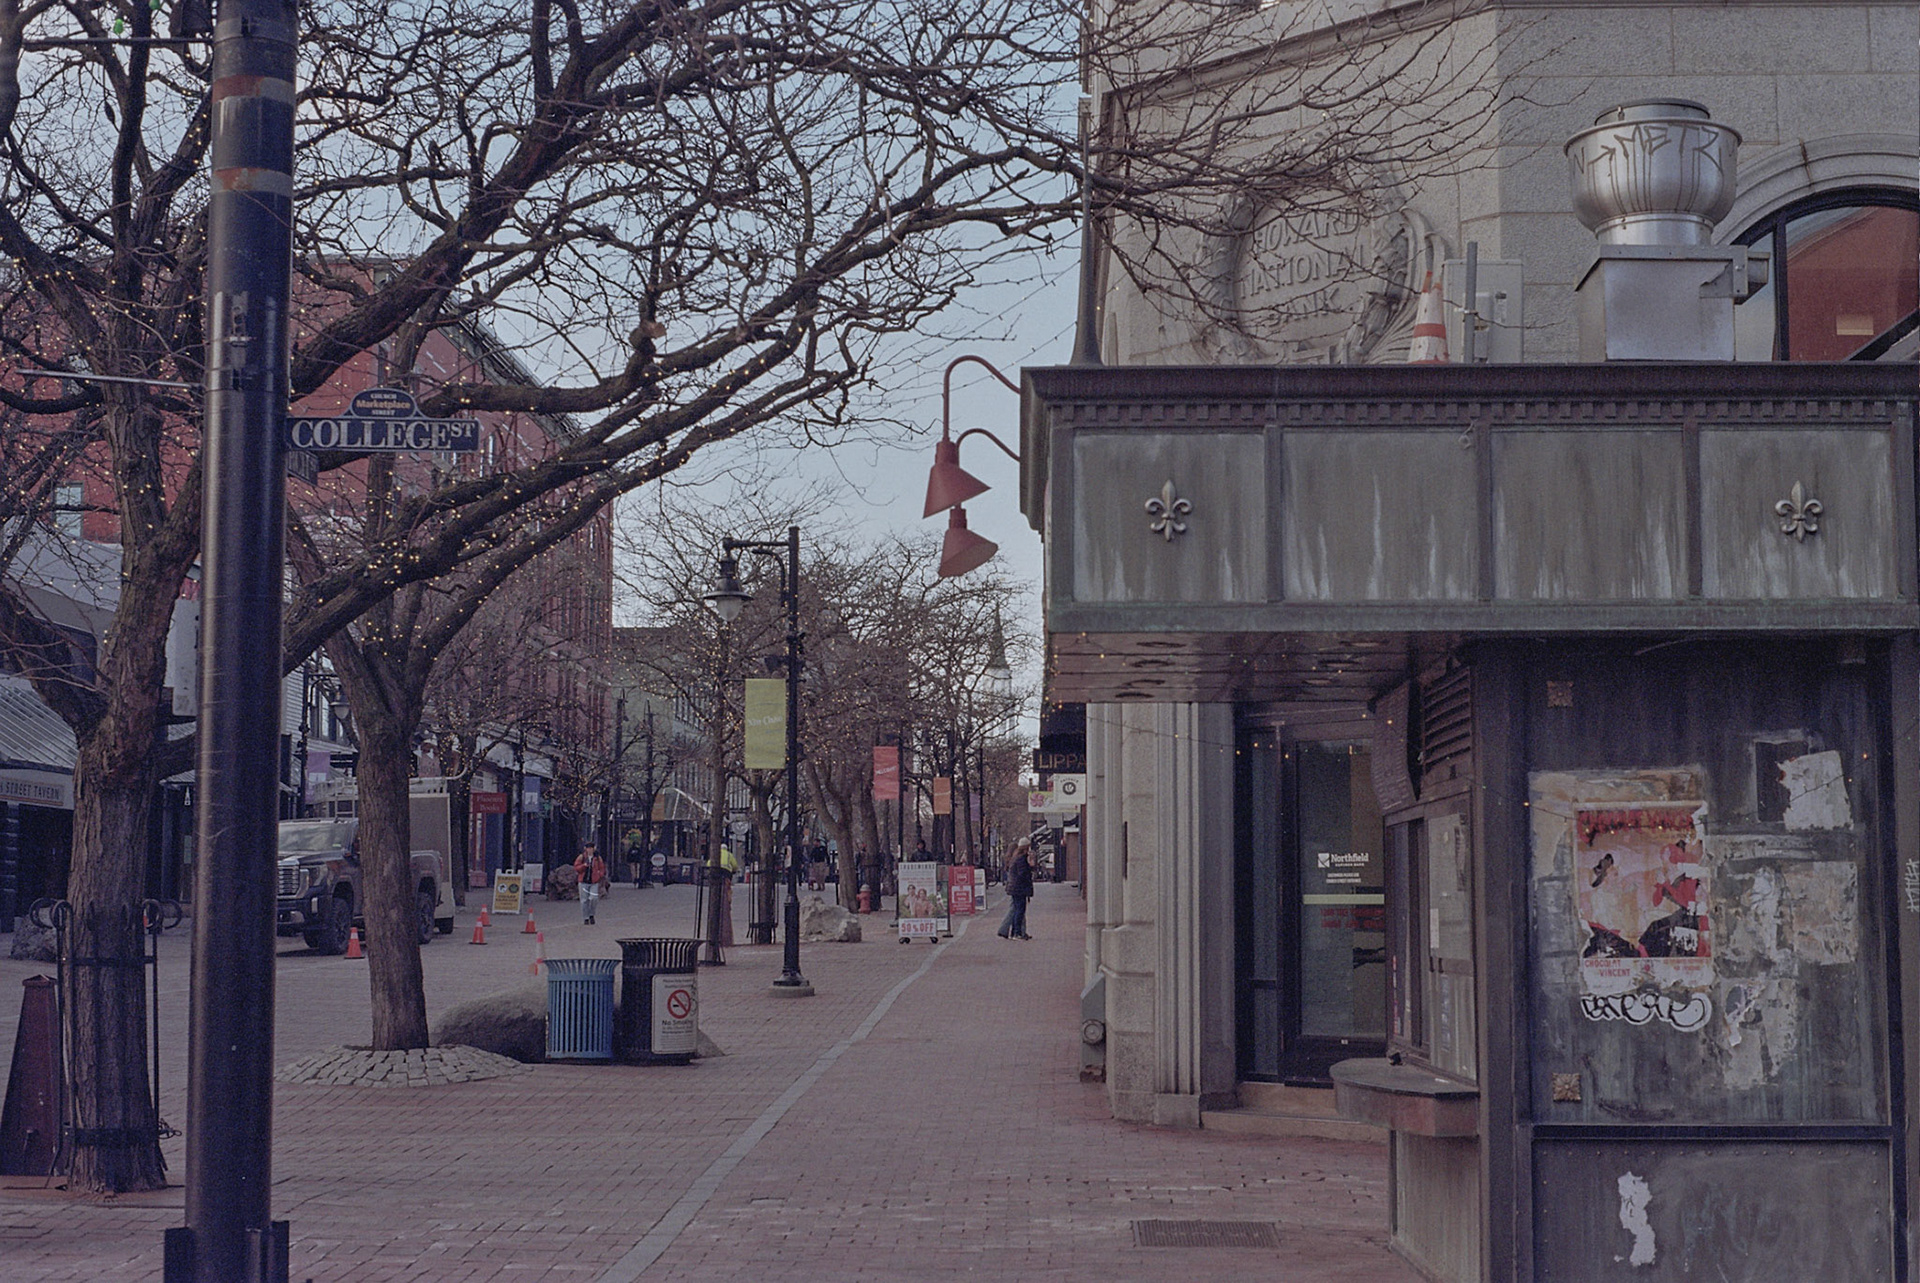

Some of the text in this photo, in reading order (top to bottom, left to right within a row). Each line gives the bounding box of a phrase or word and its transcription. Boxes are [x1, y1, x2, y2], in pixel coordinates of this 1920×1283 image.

[1240, 245, 1370, 299] NATIONAL
[356, 399, 411, 410] Marketplace
[292, 420, 475, 449] COLLEGE ST
[6, 782, 31, 796] STREET
[34, 785, 60, 800] TAVERN
[1331, 853, 1369, 862] Northfield
[919, 922, 934, 932] OFF
[1585, 959, 1620, 968] CHOCOLAT
[1600, 968, 1631, 977] VINCENT
